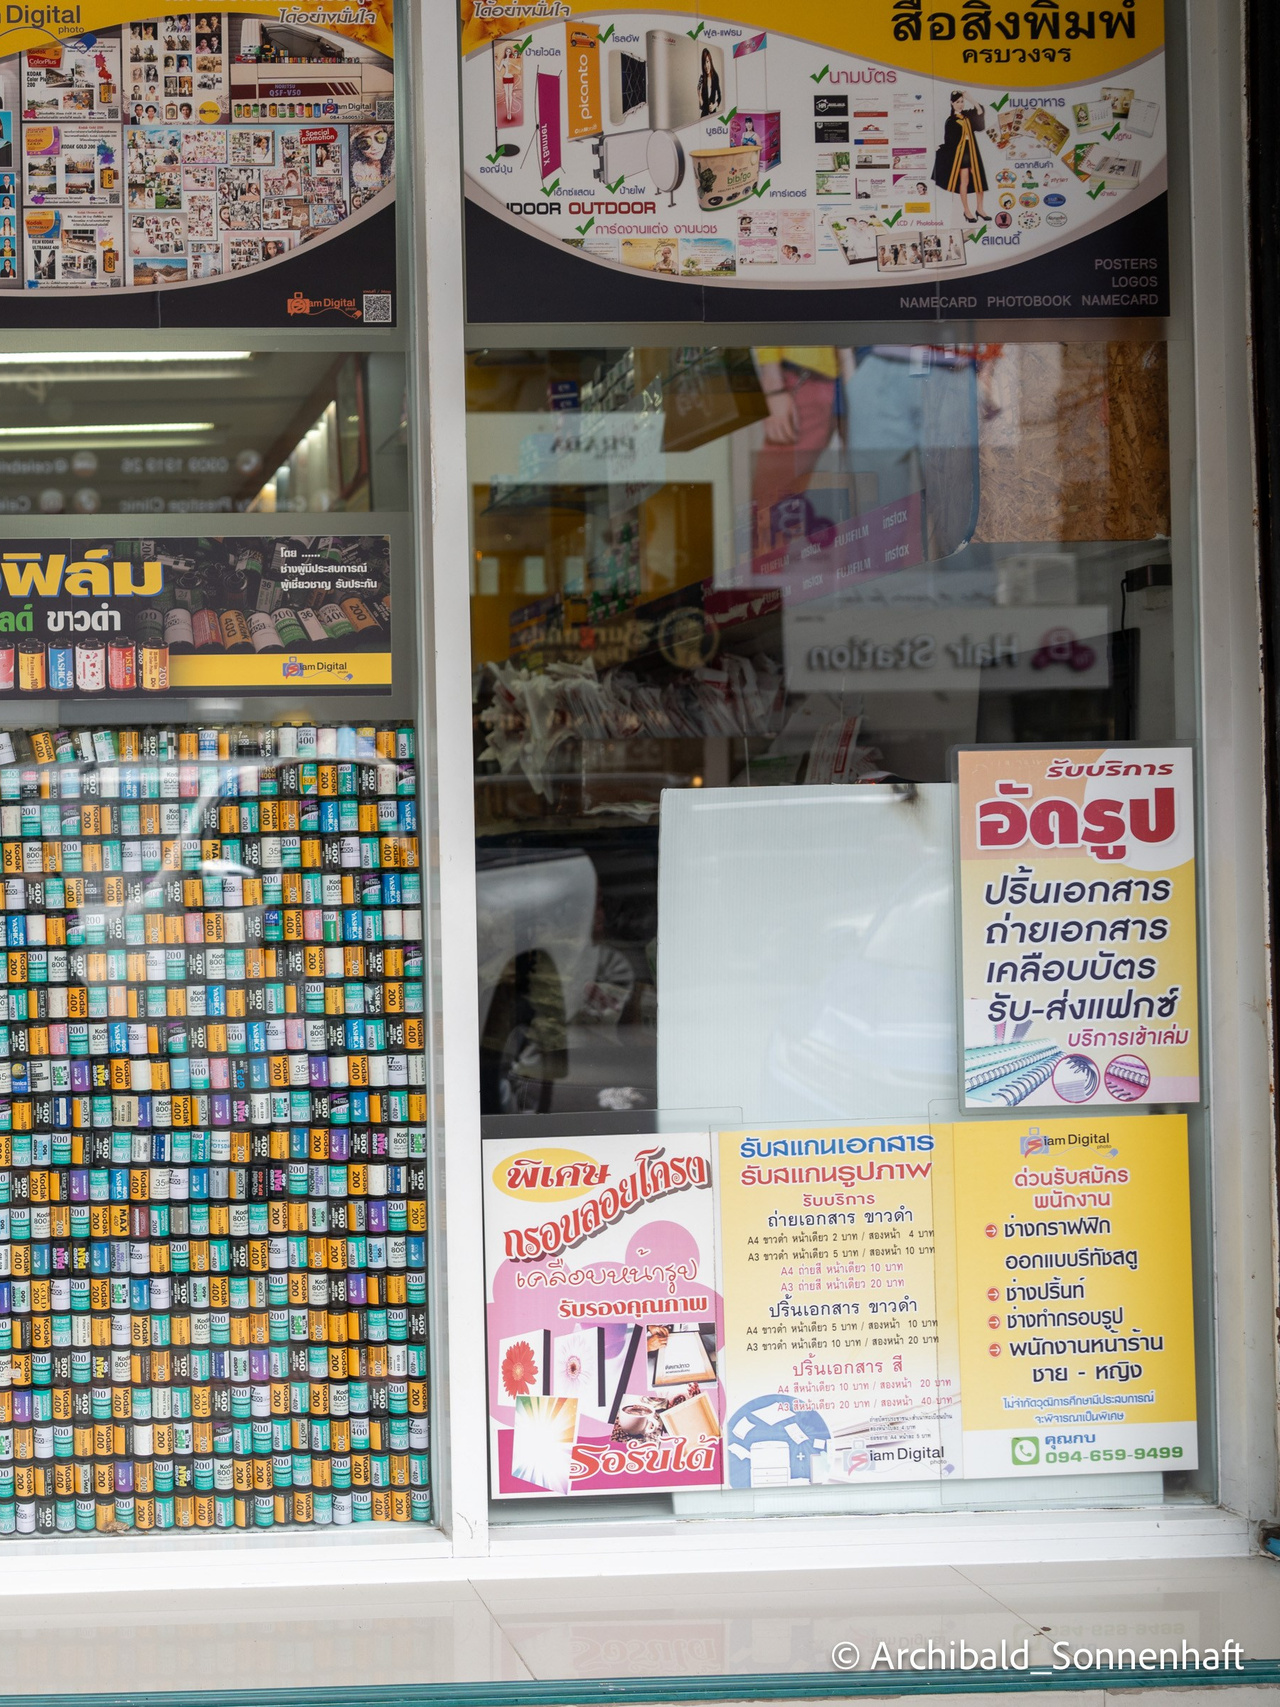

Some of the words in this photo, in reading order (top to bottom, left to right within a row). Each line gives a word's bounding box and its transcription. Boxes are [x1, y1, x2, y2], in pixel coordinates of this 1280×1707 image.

[7, 4, 80, 30] Digital
[279, 7, 376, 24] ได้อย่างมั่นใจ
[473, 1, 570, 18] ได้อย่างมั่นใจ
[58, 26, 84, 34] photo
[612, 34, 639, 43] โรลอัพ
[525, 47, 561, 57] ป้ายไวนิล
[963, 48, 1071, 63] ครบวงจร
[829, 67, 897, 84] นามบัตร
[580, 54, 592, 120] picanto
[1009, 97, 1065, 110] เมนูอาหาร
[302, 134, 334, 143] promotion
[305, 129, 329, 137] Special
[480, 165, 513, 175] ธงญี่ปุ่น
[619, 186, 645, 194] ป้ายไฟ
[568, 202, 656, 214] OUTDOOR
[595, 222, 669, 235] การ์ดงานแต่ง
[674, 223, 718, 234] งานบวช
[916, 219, 944, 227] Photobook
[981, 231, 1022, 246] สแตนดี้
[1095, 259, 1158, 270] POSTERS
[1112, 277, 1158, 287] LOGOS
[900, 297, 977, 308] NAMECARD
[987, 296, 1072, 307] PHOTOBOOK
[1082, 294, 1158, 306] NAMECARD
[281, 547, 297, 558] โดย
[281, 562, 367, 577] ช่างผู้มีประสบการณ์
[281, 577, 331, 591] ผู้เชี่ยวชาญ
[336, 578, 377, 590] รับประกัน
[47, 602, 121, 632] ขาวดำ
[317, 661, 347, 673] Digital
[42, 732, 53, 760] Kodak
[1047, 760, 1174, 777] รับบริการ
[979, 783, 1175, 860] อัดรูป
[986, 866, 1171, 905] ปริ้นเอกสาร
[986, 913, 1168, 944] ถ่ายเอกสาร
[987, 951, 1156, 983] เคลือบบัตร
[988, 987, 1178, 1022] รับ-ส่งแฟกซ์
[1068, 1024, 1189, 1047] บริการเข้าเล่ม
[740, 1135, 935, 1158] รับสแกนเอกสาร
[1068, 1133, 1109, 1147] Digital
[508, 1159, 611, 1189] พิเศษ
[741, 1162, 932, 1188] รับสแกนรูปภาพ
[1014, 1165, 1129, 1187] ด่วนรับสมัคร
[504, 1146, 705, 1257] กรอบลอยโครง
[803, 1193, 875, 1207] รับบริการ
[1034, 1191, 1110, 1209] พนักงาน
[768, 1210, 855, 1227] ถ่ายเอกสาร
[864, 1205, 913, 1223] ขาวดำ
[1004, 1215, 1110, 1238] ช่างกราฟฟิก
[748, 1236, 759, 1245] A4
[763, 1233, 788, 1244] ขาวดำ
[792, 1230, 829, 1243] หน้าเดียว
[842, 1232, 857, 1241] บาท
[869, 1228, 900, 1240] สองหน้า
[918, 1230, 935, 1239] บาท
[1005, 1248, 1138, 1270] ออกแบบรีทัชสตู
[517, 1248, 697, 1294] เคลือบหน้ารูป
[1007, 1277, 1085, 1302] ช่างปริ้นท์
[559, 1297, 707, 1318] รับรองคุณภาพ
[769, 1294, 859, 1318] ปริ้นเอกสาร
[869, 1295, 917, 1313] ขาวดำ
[1007, 1306, 1123, 1330] ช่างทำกรอบรูป
[1010, 1329, 1163, 1357] พนักงานหน้าร้าน
[793, 1352, 883, 1377] ปริ้นเอกสาร
[893, 1355, 903, 1372] สี
[1033, 1367, 1067, 1382] ชาย
[1096, 1362, 1142, 1382] หญิง
[1035, 1411, 1124, 1424] จะพิจารณาเป็นพิเศษ
[1045, 1434, 1096, 1449] คุณกบ
[570, 1435, 717, 1479] รอรับได้
[898, 1446, 944, 1462] Digital
[1045, 1446, 1183, 1464] 094-659-9499
[77, 1501, 91, 1510] 200
